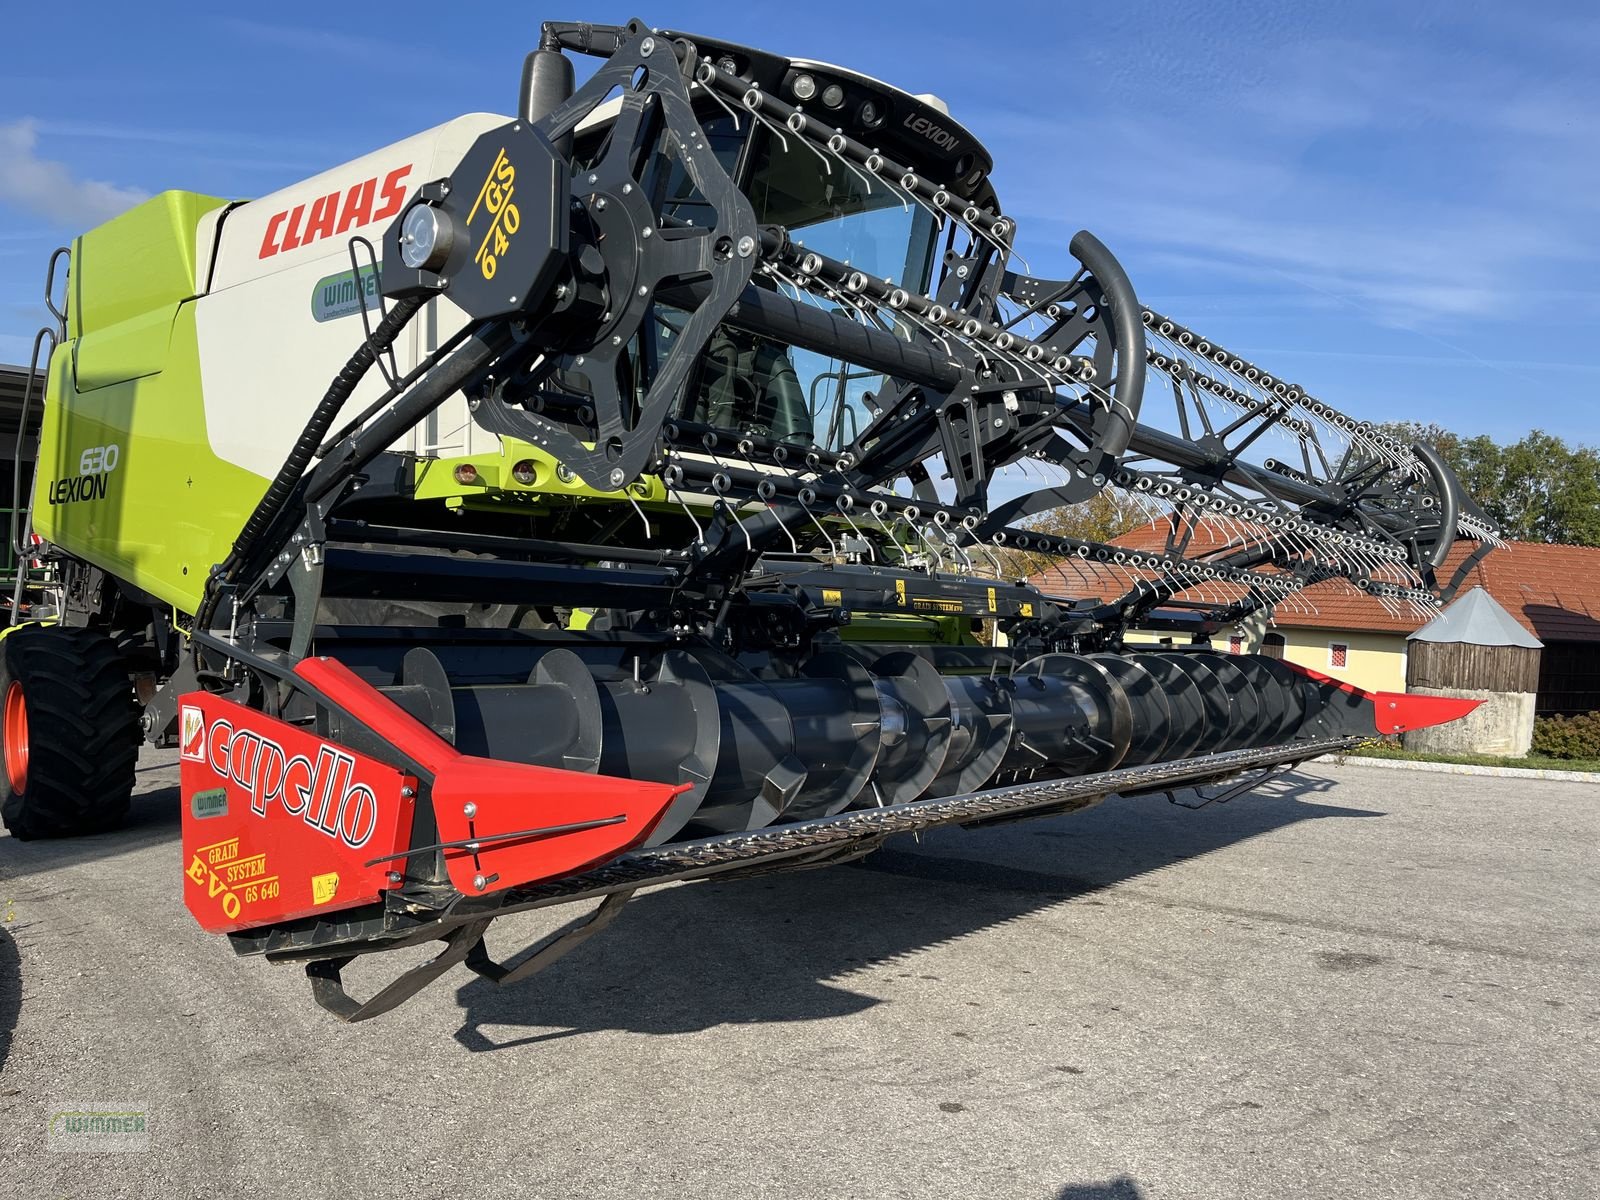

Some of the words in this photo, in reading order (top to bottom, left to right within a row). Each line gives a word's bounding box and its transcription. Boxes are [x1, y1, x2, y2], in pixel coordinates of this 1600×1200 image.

[904, 113, 959, 152] LEXION
[485, 157, 515, 214] GS
[259, 164, 413, 259] CLAAS
[481, 203, 520, 280] 640
[80, 444, 119, 476] 630
[49, 473, 108, 505] LEXION
[932, 603, 953, 611] SYSTEM
[208, 842, 239, 864] GRAIN
[227, 858, 266, 882] SYSTEM
[185, 854, 241, 919] EVO
[245, 886, 258, 903] GS
[261, 881, 280, 900] 640
